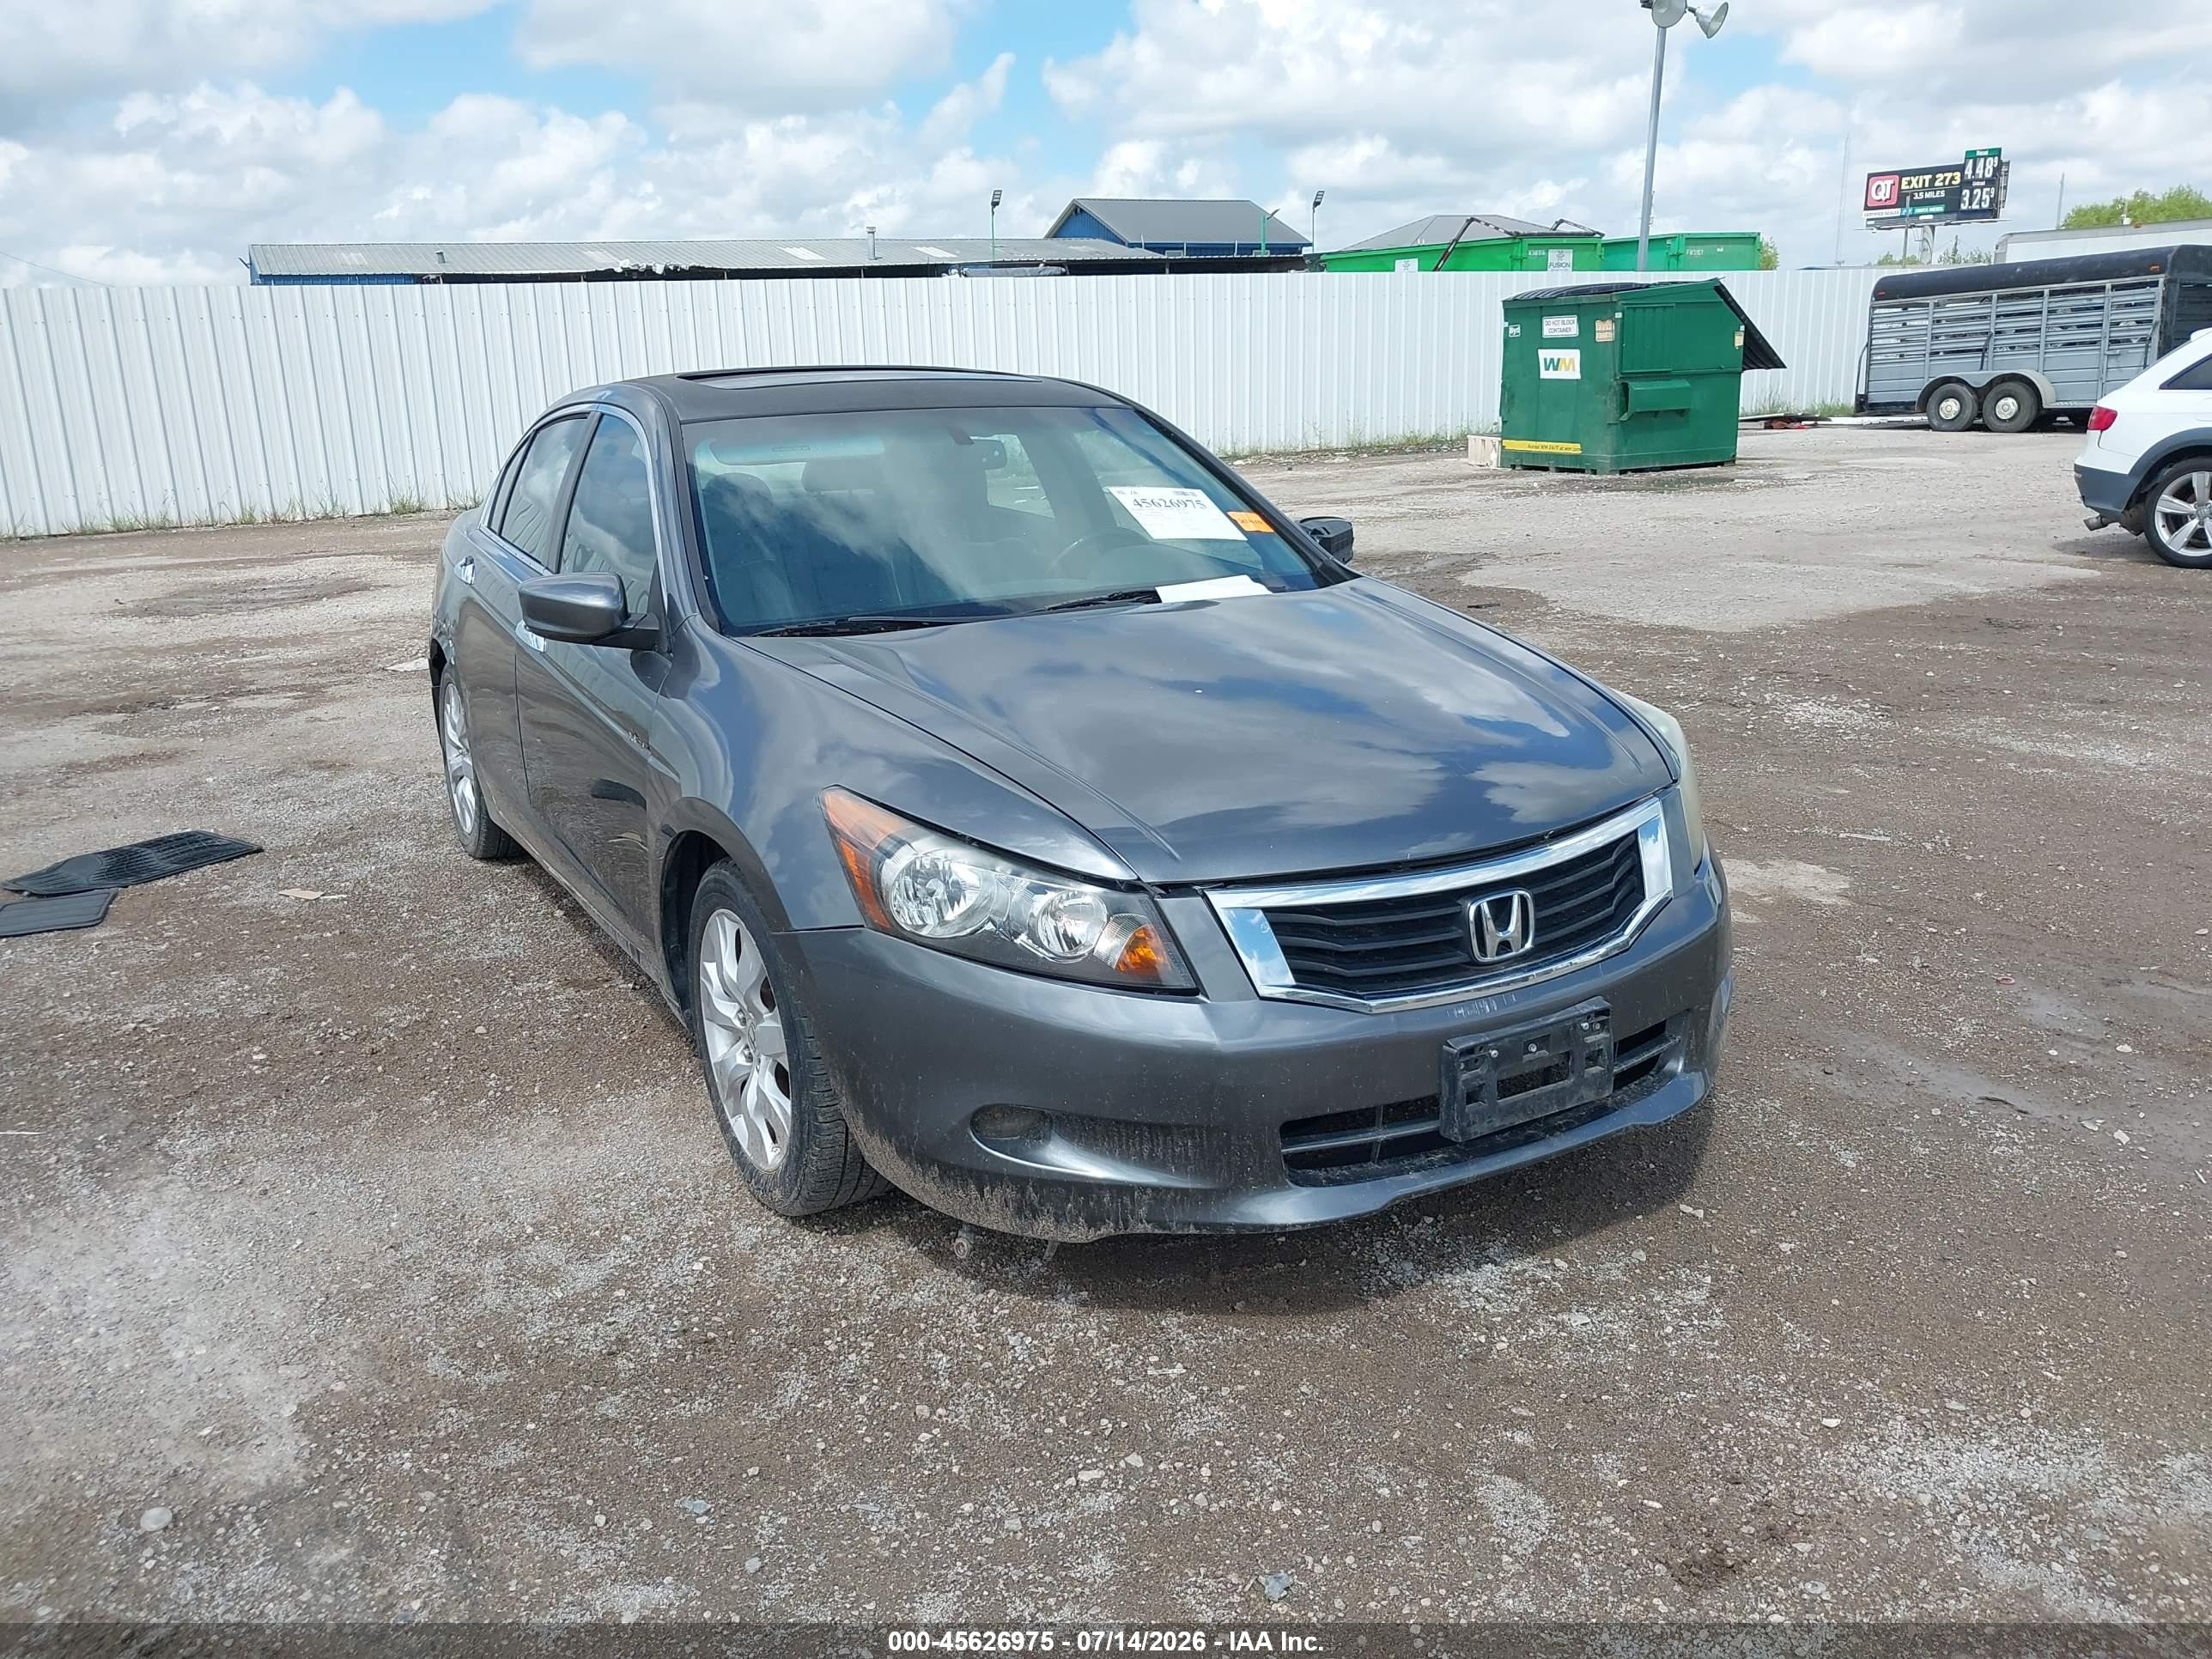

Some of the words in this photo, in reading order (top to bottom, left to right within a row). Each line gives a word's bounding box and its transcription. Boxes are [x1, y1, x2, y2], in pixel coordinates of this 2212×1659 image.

[1900, 174, 1933, 190] EXIT
[1934, 171, 1961, 187] 273
[1870, 179, 1895, 202] QT
[1924, 190, 1946, 199] MILES
[1543, 357, 1576, 372] WM
[1133, 498, 1207, 509] 45626975
